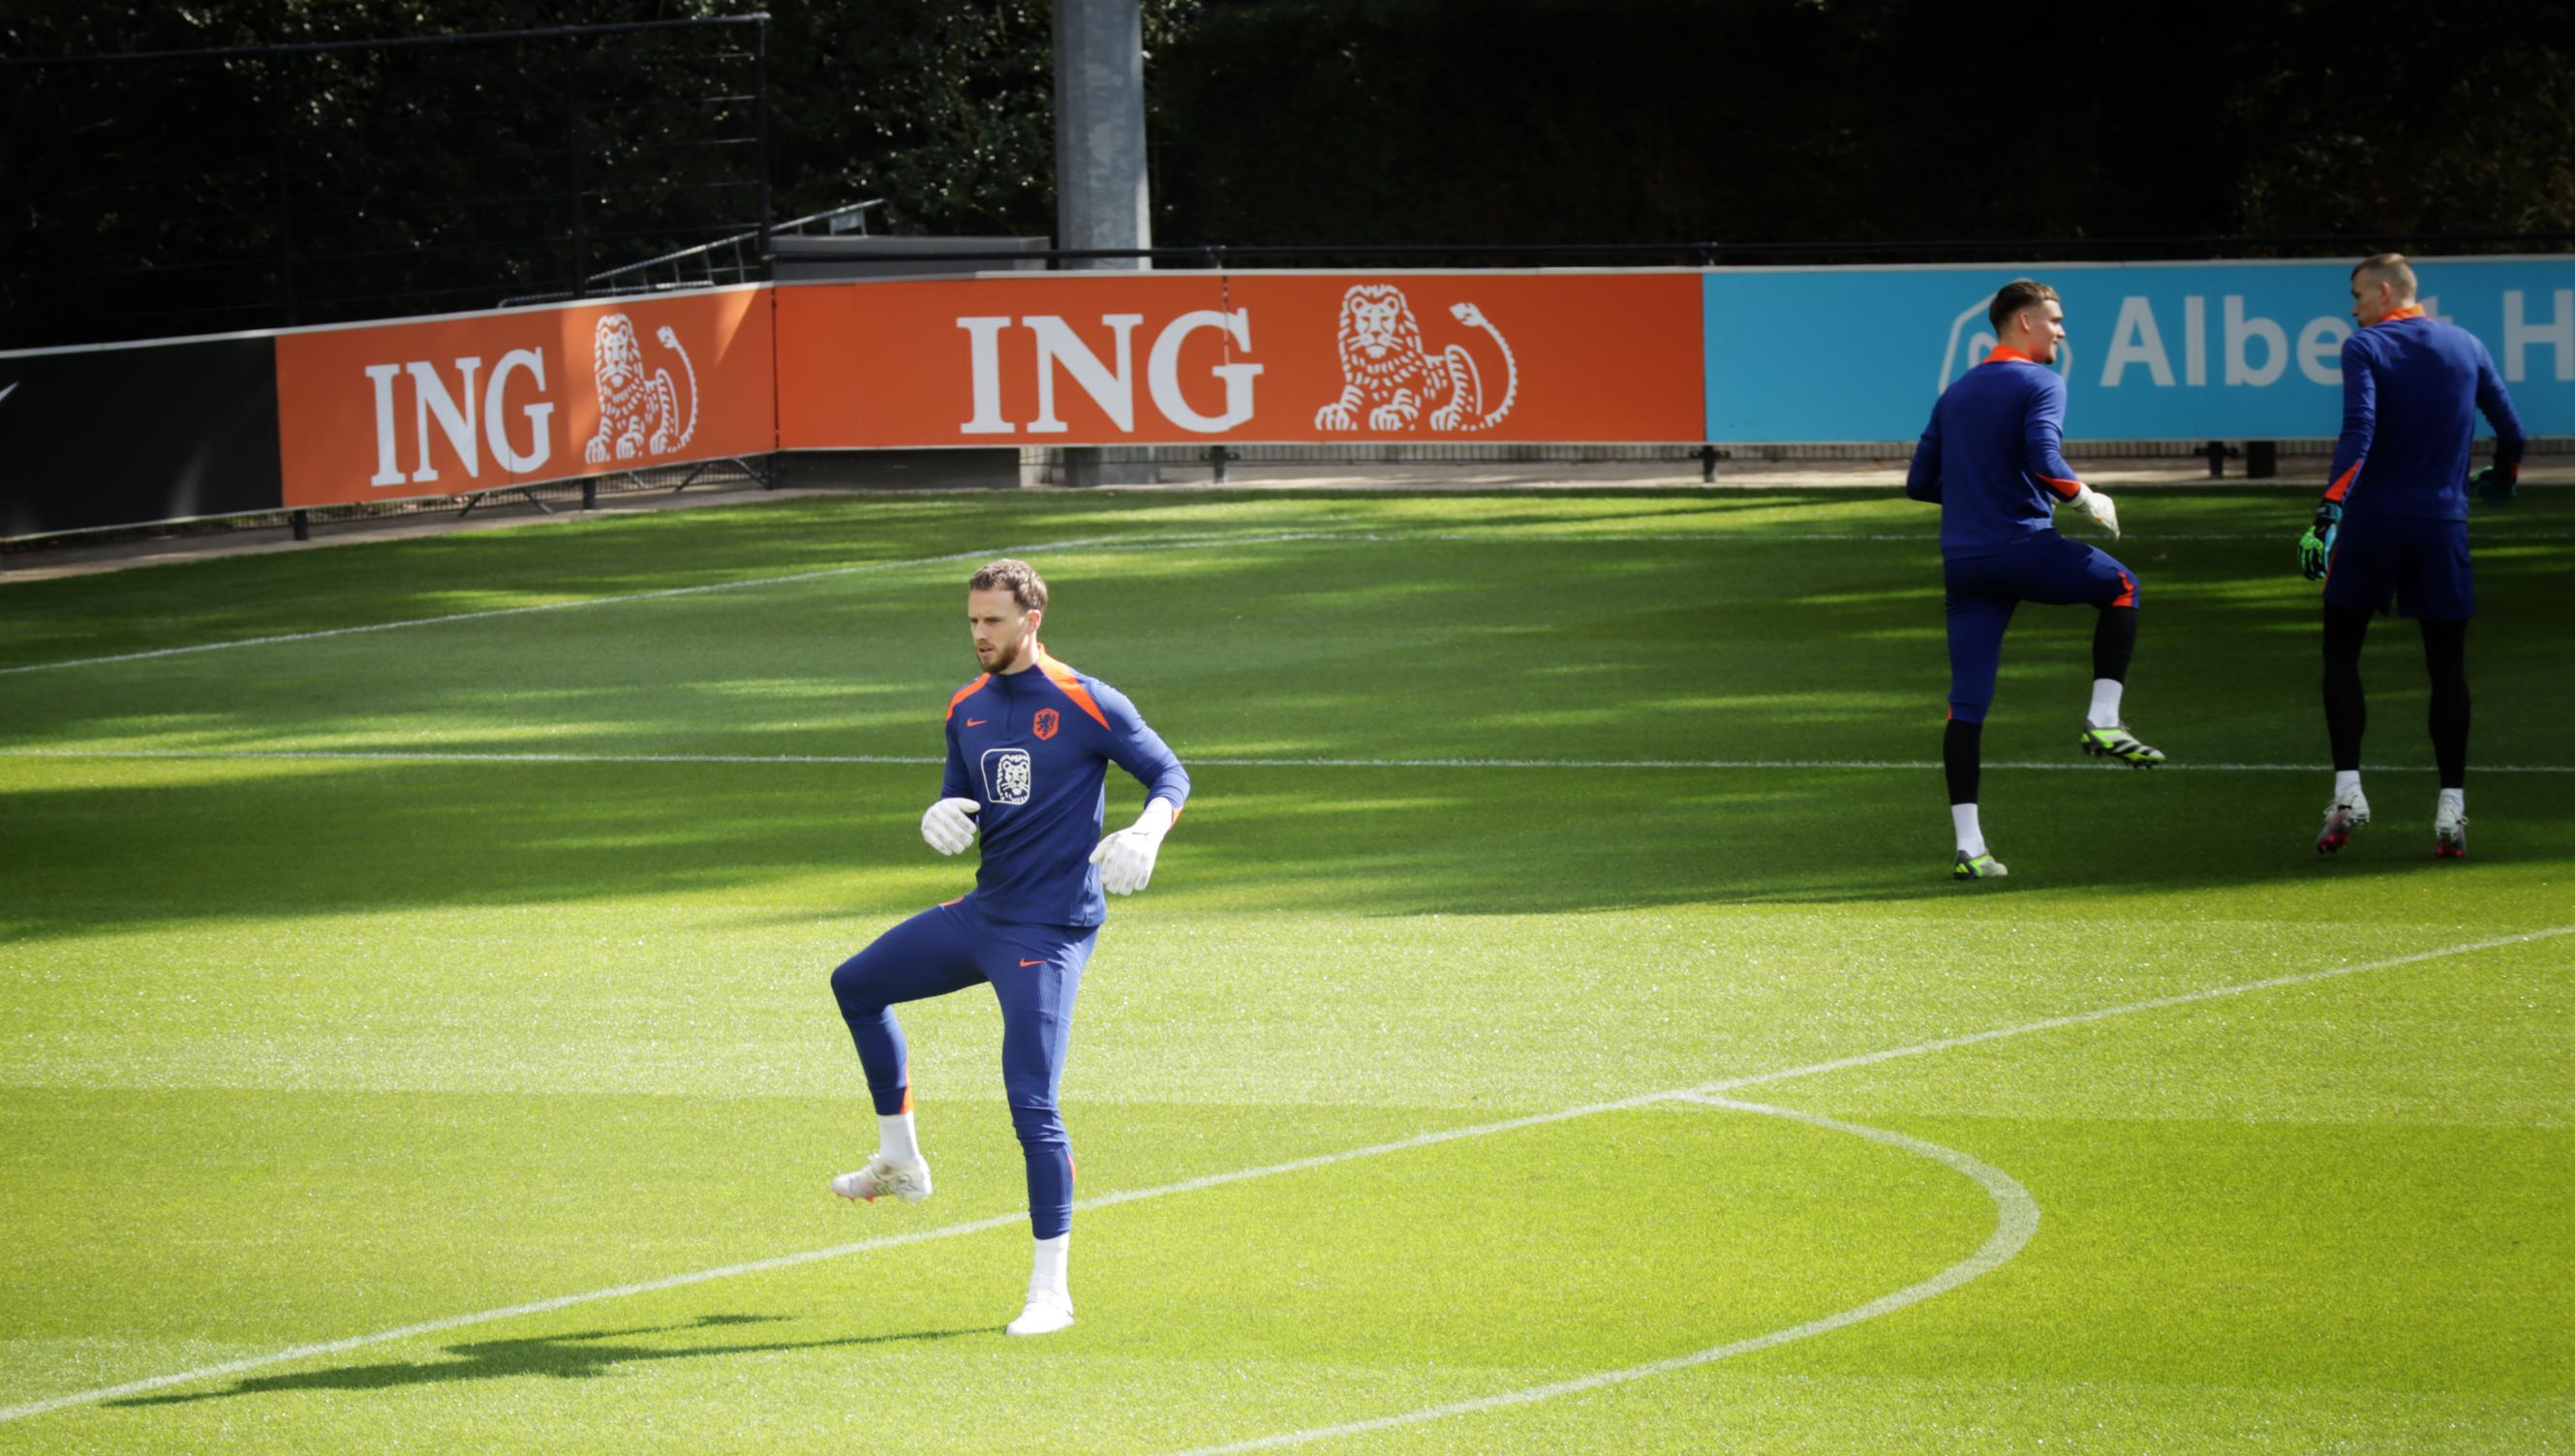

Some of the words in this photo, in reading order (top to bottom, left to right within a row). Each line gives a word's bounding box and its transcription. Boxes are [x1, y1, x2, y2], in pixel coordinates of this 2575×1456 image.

[956, 308, 1265, 435] ING
[2100, 294, 2453, 387] Albe
[364, 346, 555, 487] ING
